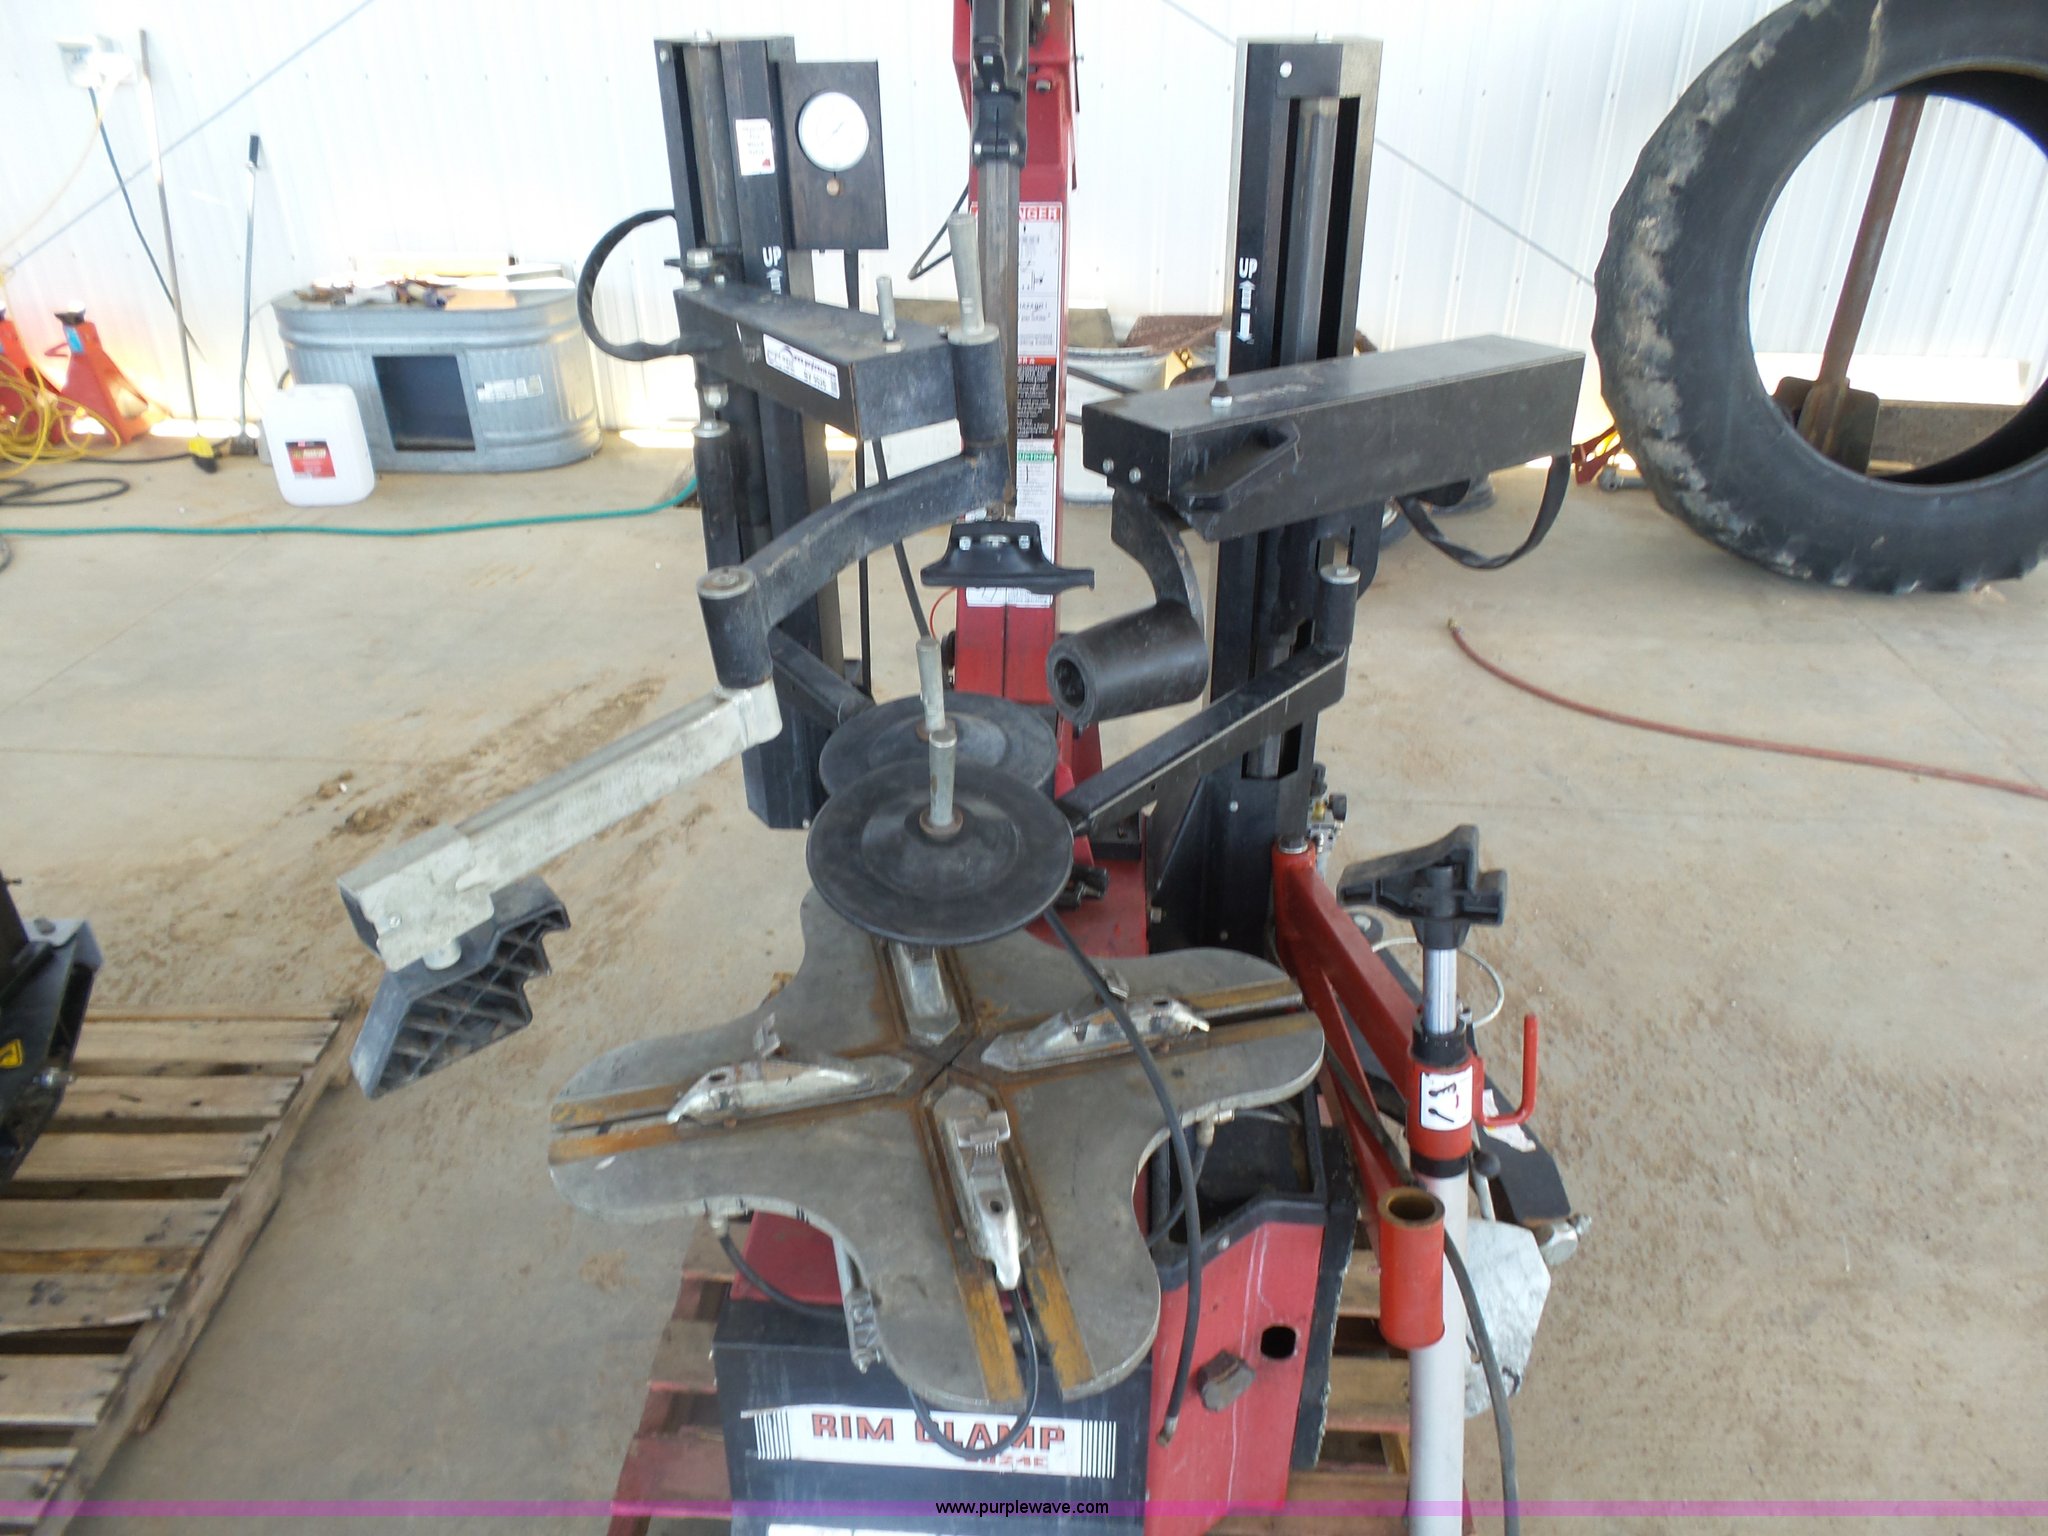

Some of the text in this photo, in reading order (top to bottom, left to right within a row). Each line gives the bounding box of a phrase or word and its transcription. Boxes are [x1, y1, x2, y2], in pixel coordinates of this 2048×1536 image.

[1019, 206, 1057, 222] NGER
[762, 246, 782, 268] UP
[1239, 257, 1258, 279] UP
[812, 1413, 1065, 1451] RIM CLAMP
